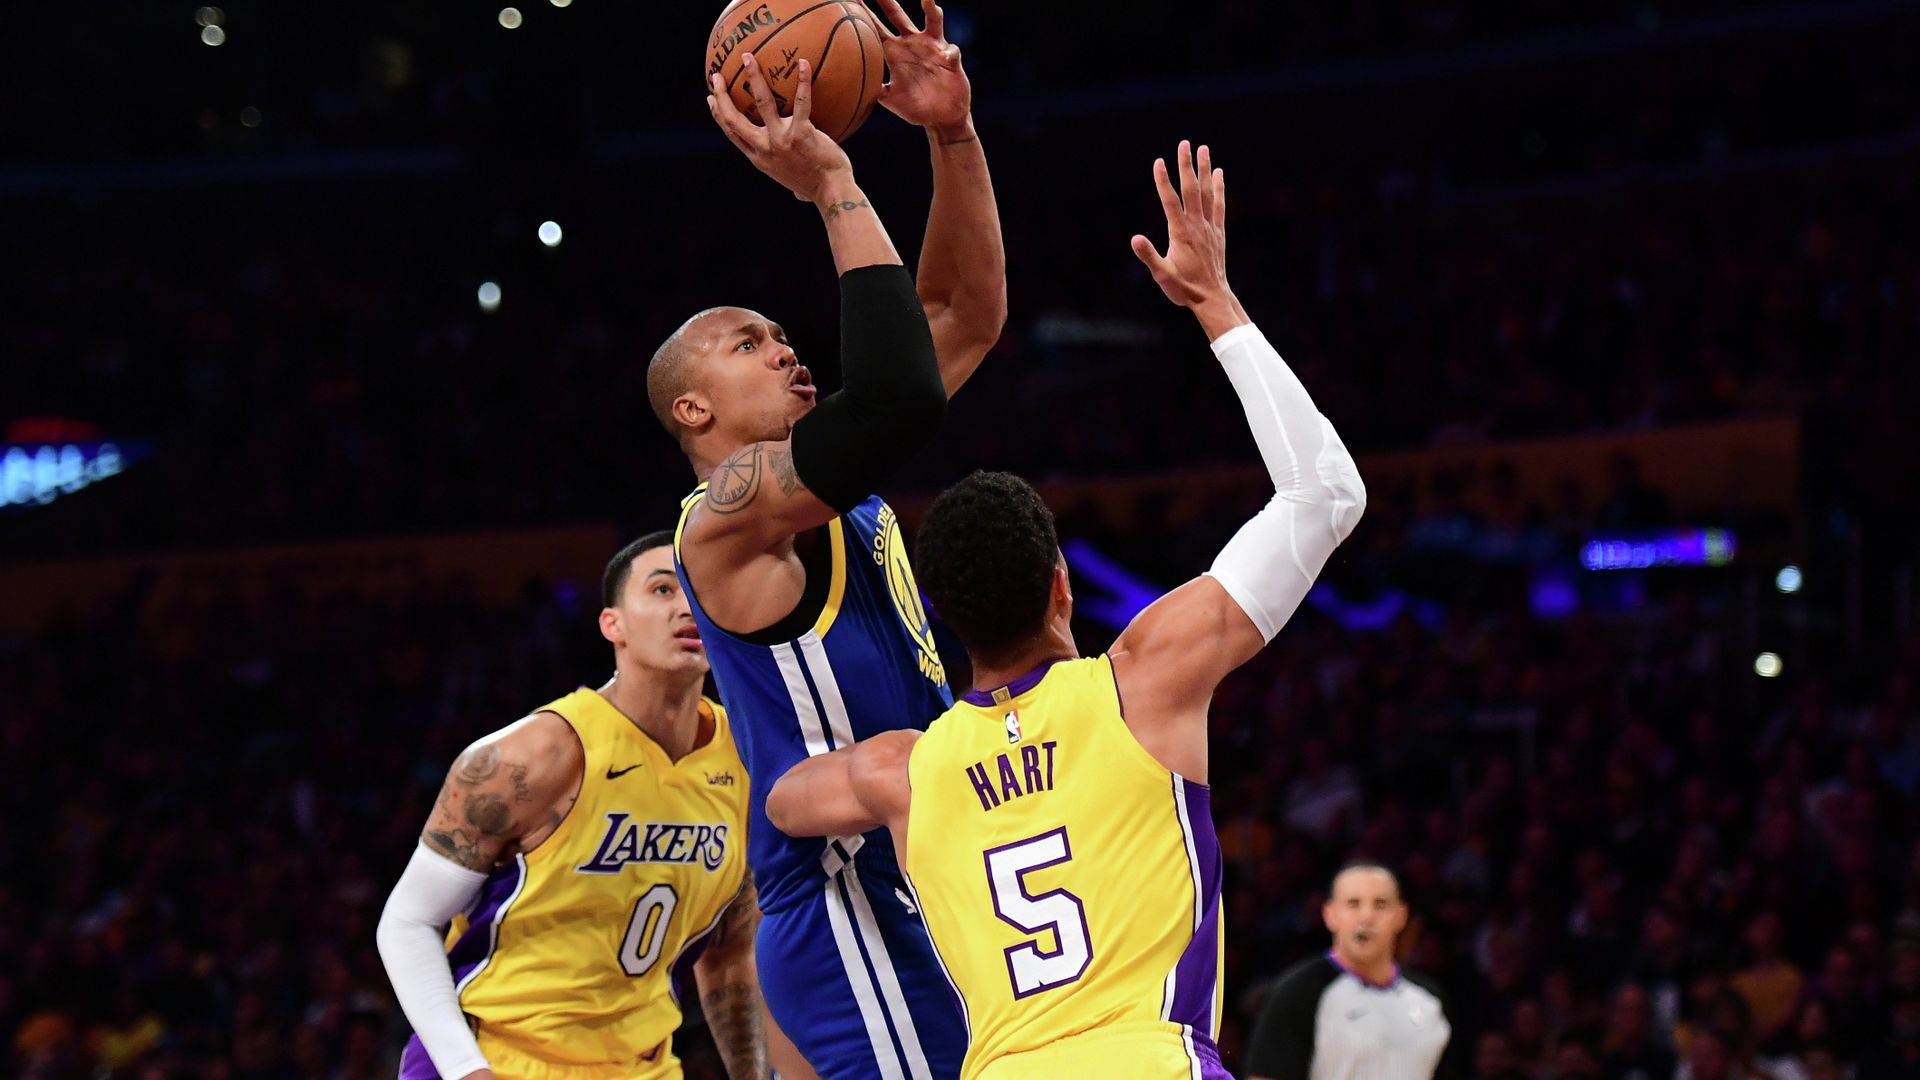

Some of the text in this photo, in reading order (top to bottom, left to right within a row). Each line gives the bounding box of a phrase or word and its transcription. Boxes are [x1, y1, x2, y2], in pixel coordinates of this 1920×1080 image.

[704, 771, 733, 786] wish
[966, 741, 1057, 812] HART
[618, 883, 679, 977] 0
[983, 825, 1094, 1000] 5
